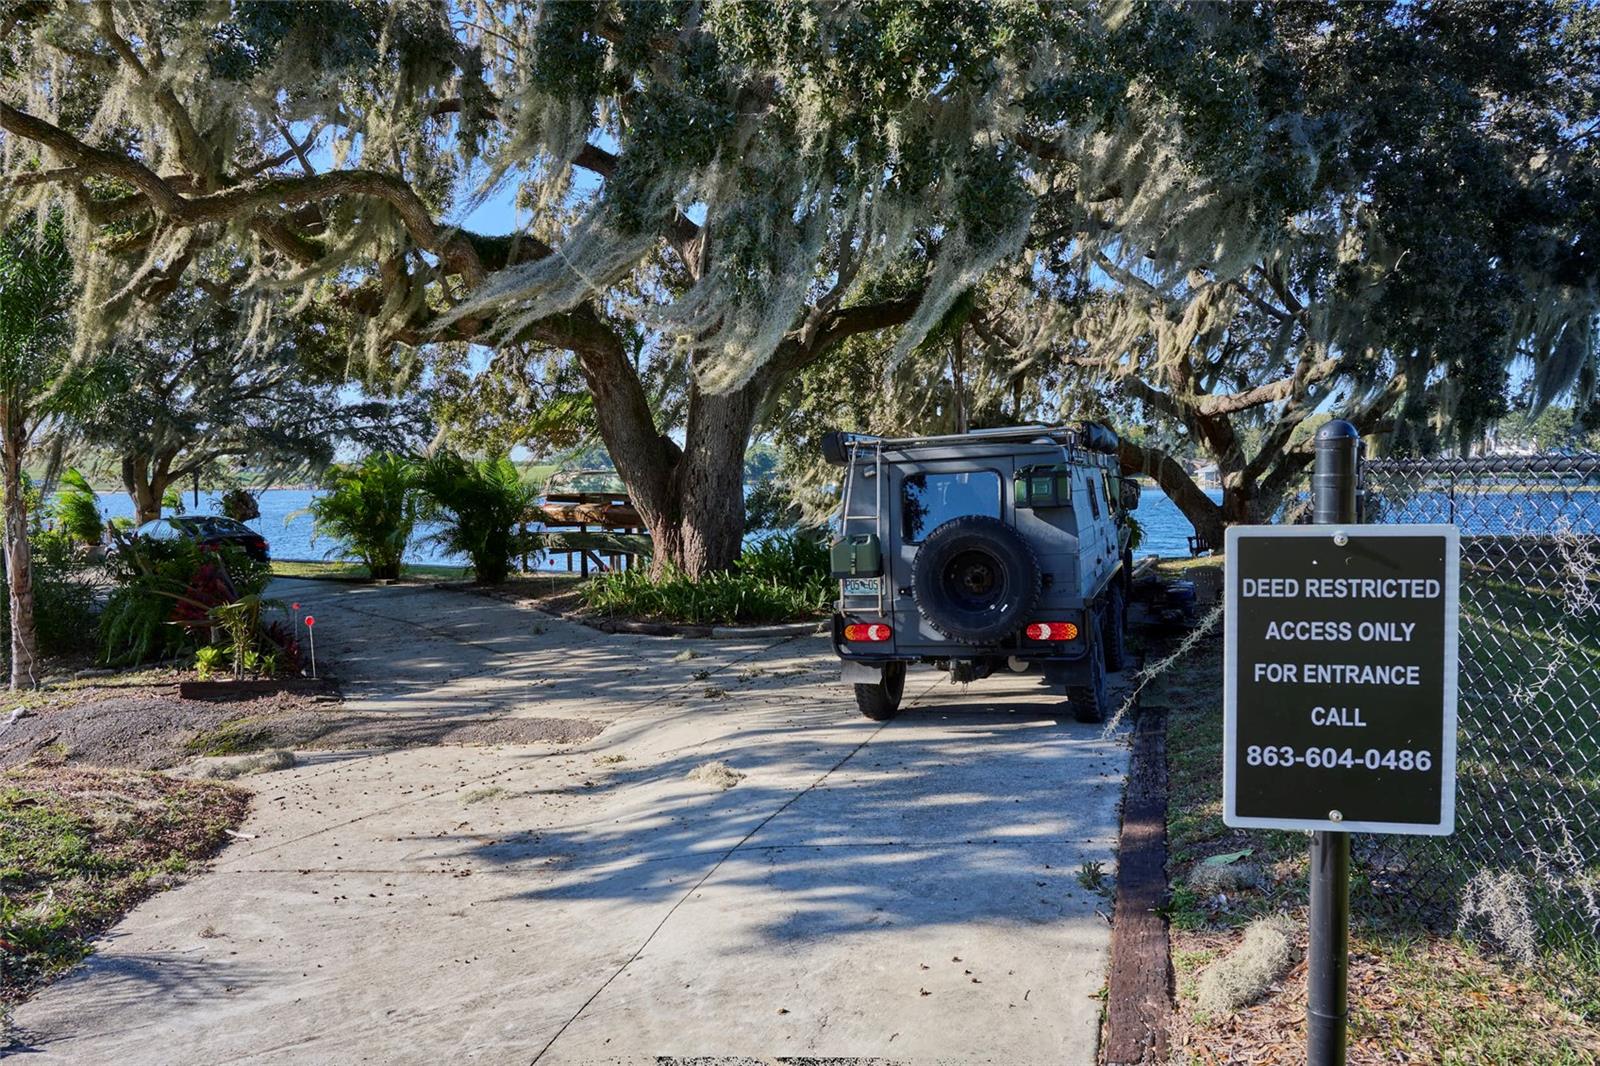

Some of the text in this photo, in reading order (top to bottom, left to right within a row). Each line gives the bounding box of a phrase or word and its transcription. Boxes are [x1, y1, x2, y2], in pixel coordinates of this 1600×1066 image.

[1242, 578, 1440, 599] DEED RESTRICTED
[1265, 621, 1416, 642] ACCESS ONLY
[1254, 663, 1420, 685] FOR ENTRANCE
[1311, 706, 1367, 727] CALL
[1246, 745, 1432, 771] 863-604-0486
